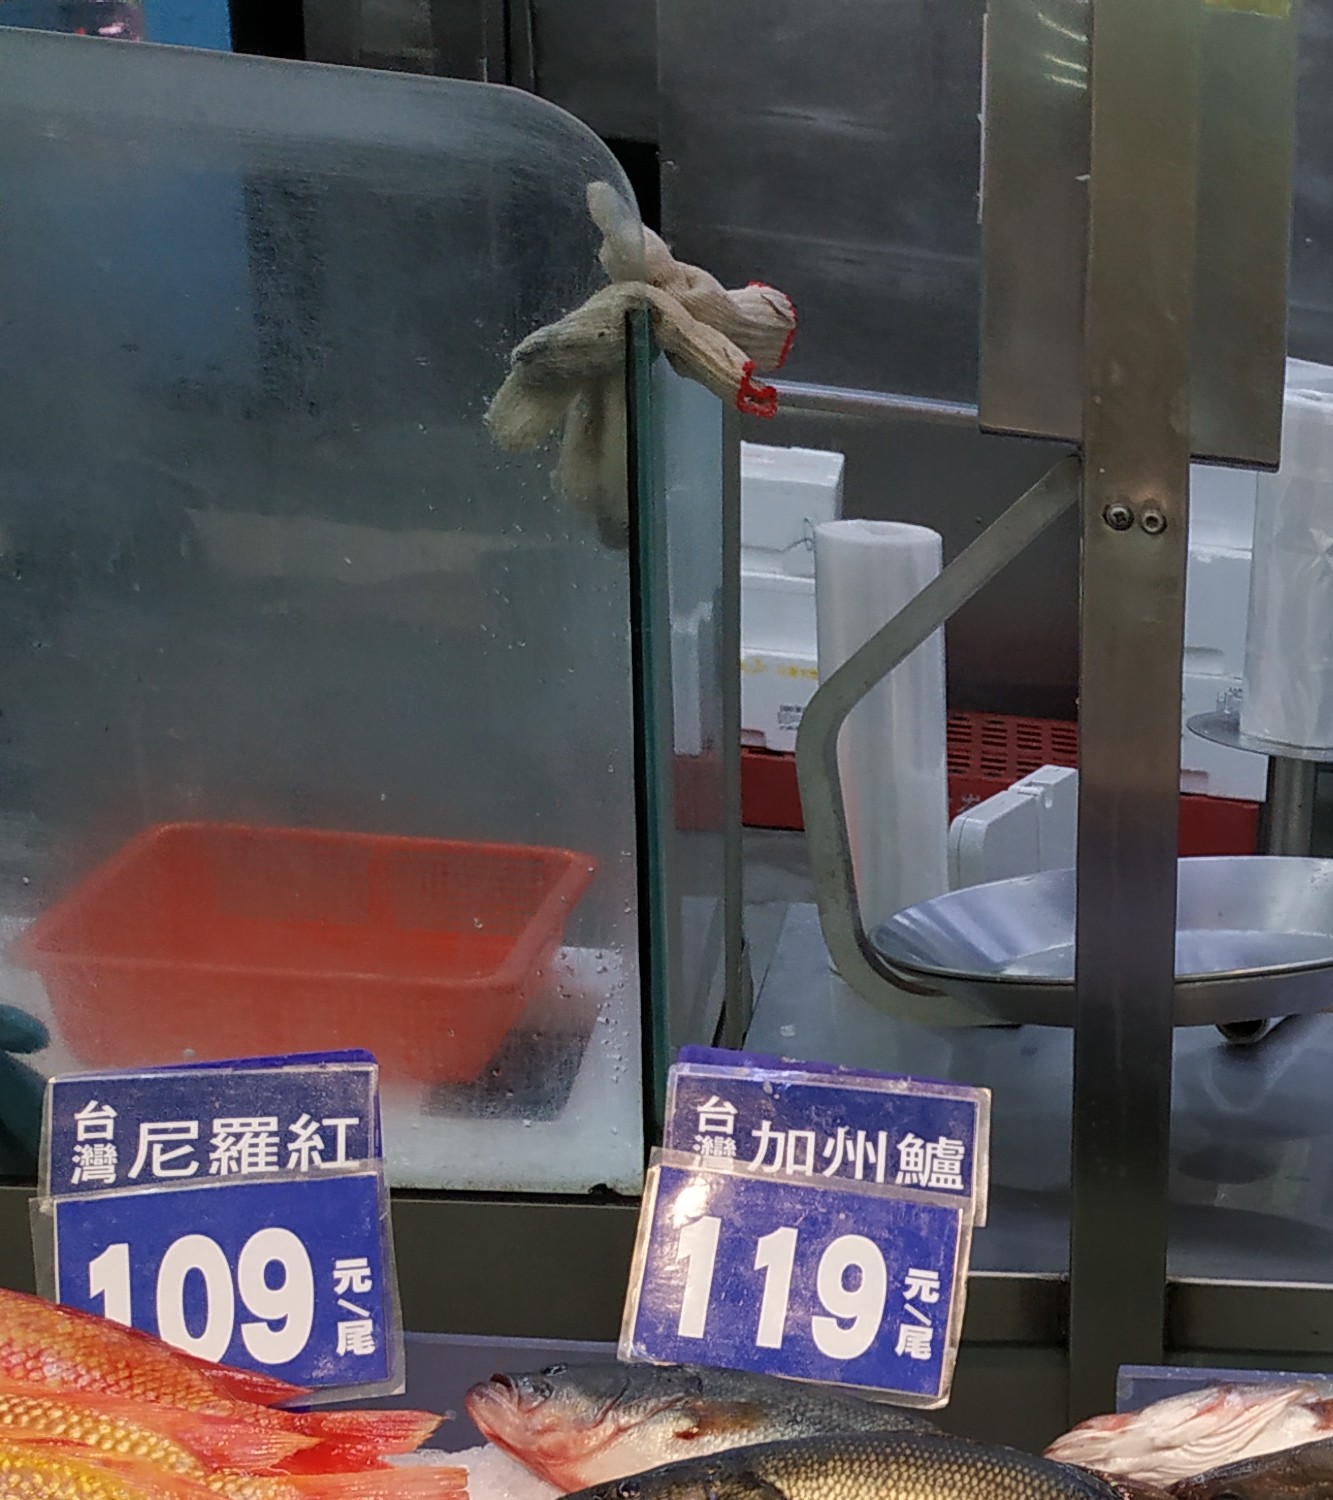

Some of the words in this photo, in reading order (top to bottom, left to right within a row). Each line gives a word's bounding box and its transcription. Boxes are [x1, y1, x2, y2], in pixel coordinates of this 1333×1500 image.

[70, 1100, 119, 1186] 台灣
[127, 1114, 361, 1179] 尼羅紅
[693, 1096, 738, 1173] 台灣
[747, 1120, 966, 1191] 加州鱸
[89, 1227, 315, 1364] 109
[674, 1215, 888, 1360] 119
